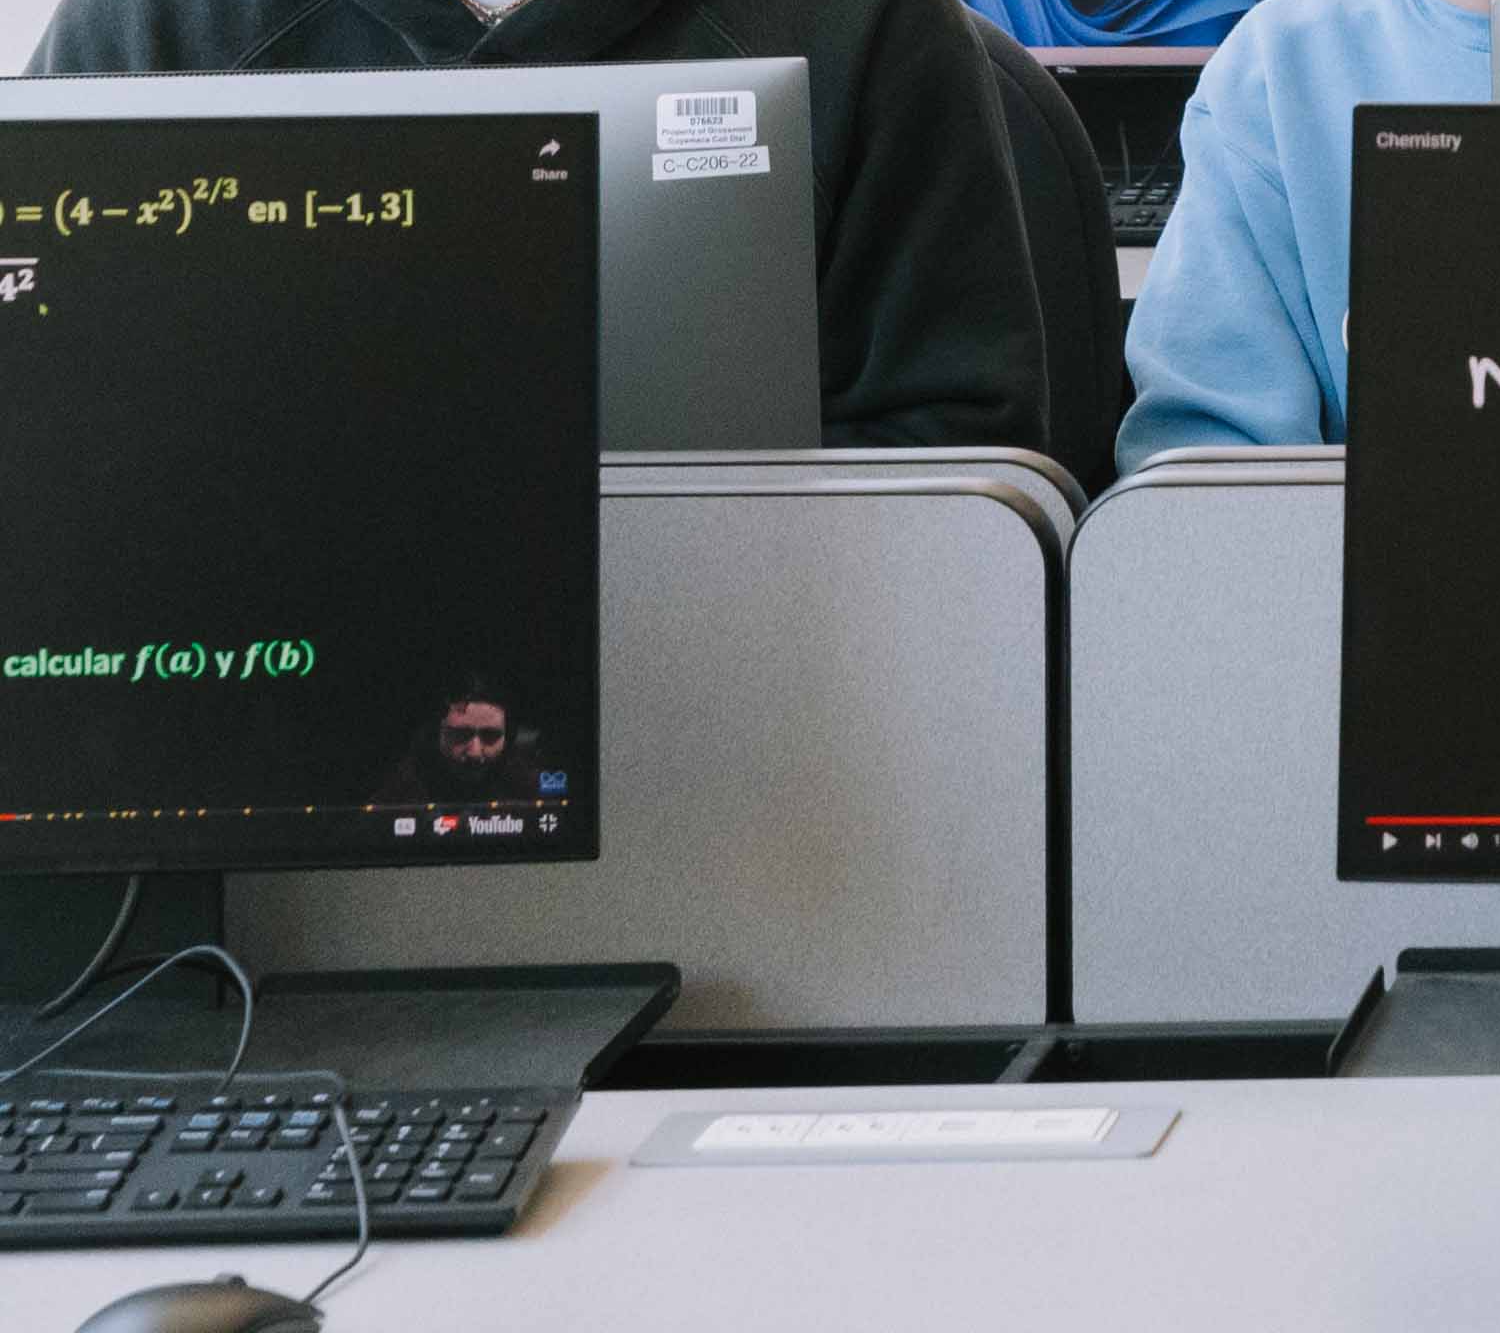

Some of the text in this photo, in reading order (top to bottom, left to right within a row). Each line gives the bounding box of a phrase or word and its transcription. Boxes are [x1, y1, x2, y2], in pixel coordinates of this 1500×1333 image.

[1375, 131, 1462, 153] Chemistry
[663, 152, 759, 174] C-C206-22
[532, 168, 569, 182] Share
[247, 199, 288, 225] en
[3, 648, 125, 679] calcular
[214, 649, 235, 679] y
[468, 814, 524, 835] YouTube
